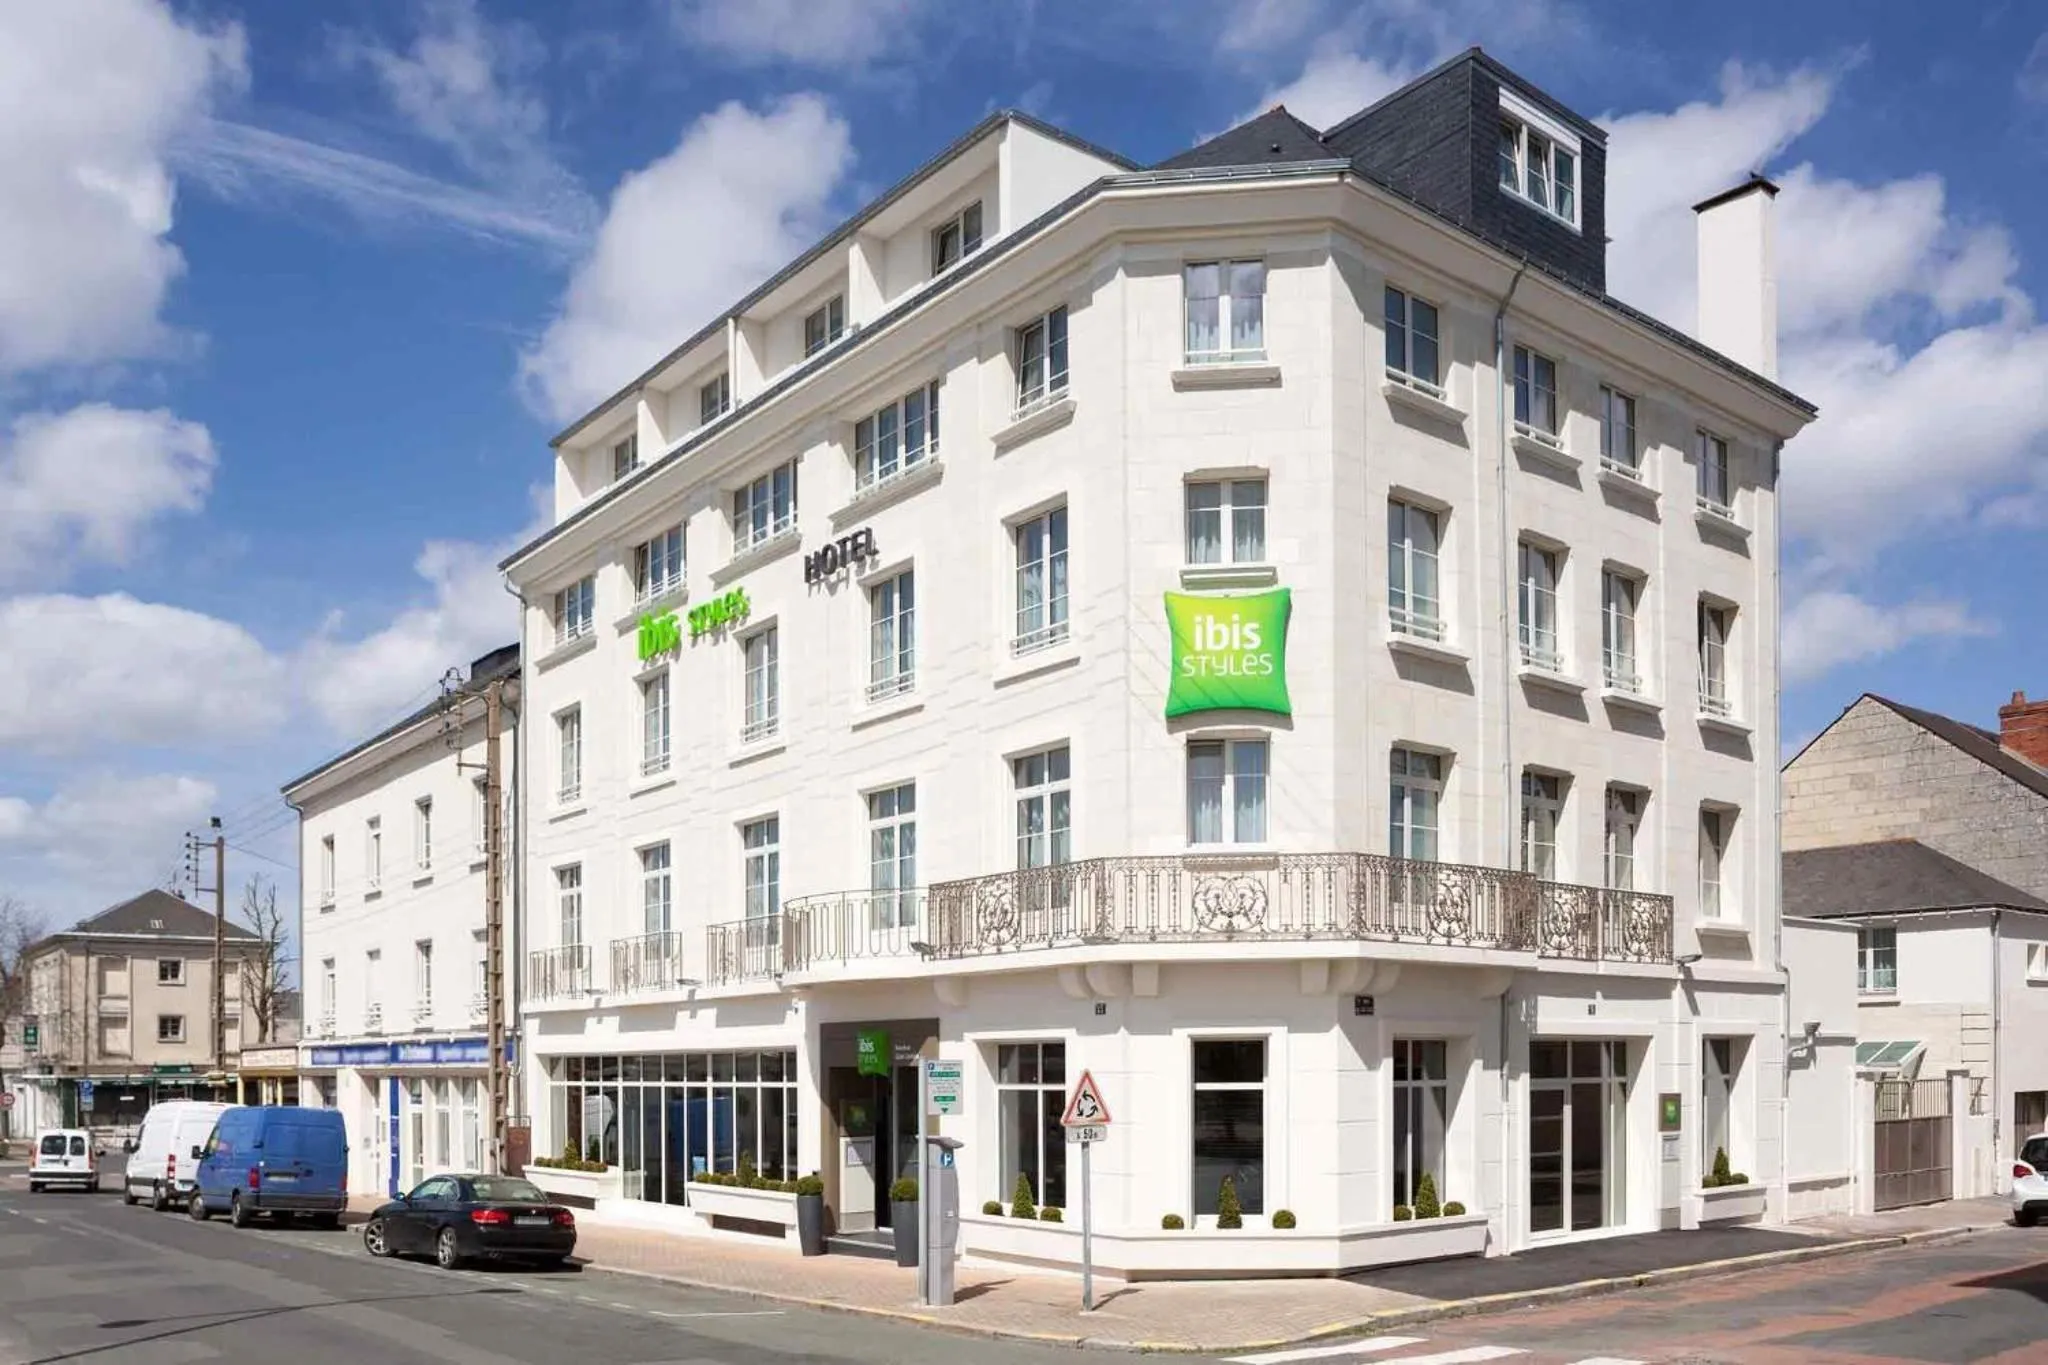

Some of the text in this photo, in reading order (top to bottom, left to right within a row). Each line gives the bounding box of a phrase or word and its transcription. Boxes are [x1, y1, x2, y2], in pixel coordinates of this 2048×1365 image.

[803, 526, 880, 584] HOTEL
[637, 608, 681, 661] ibis
[1194, 614, 1262, 652] ibis
